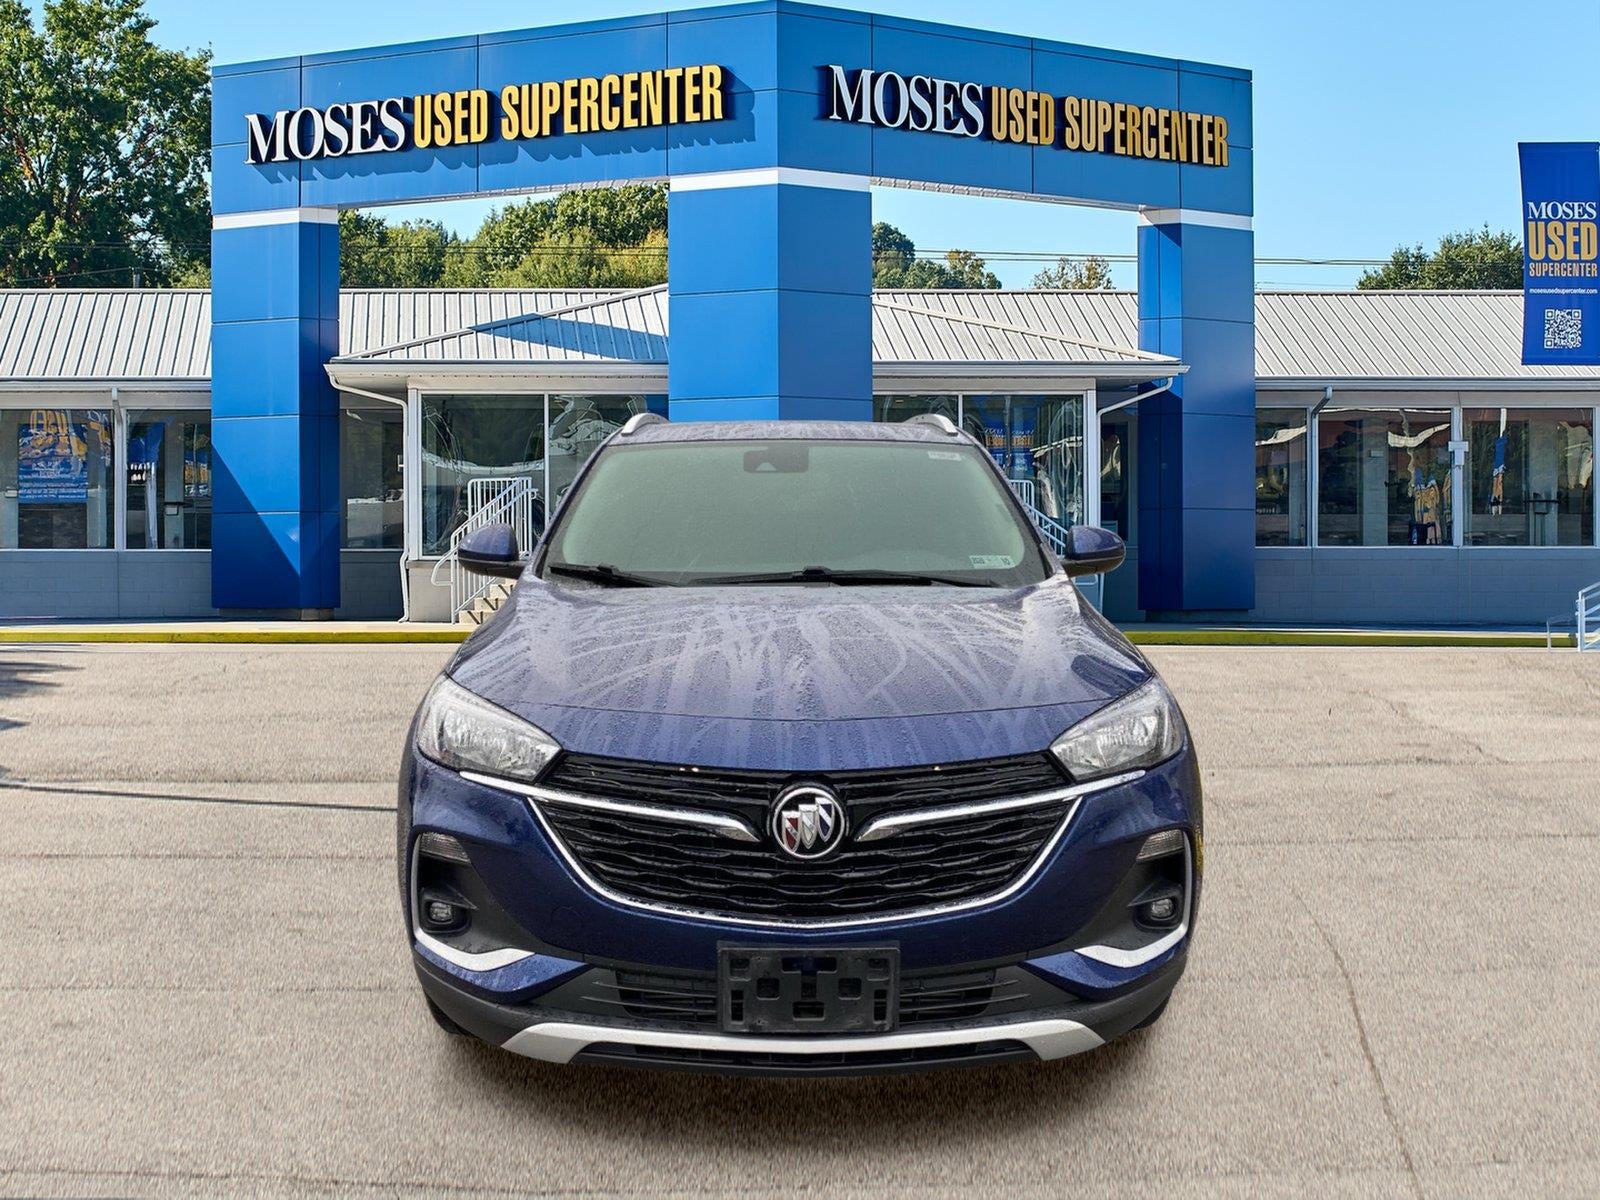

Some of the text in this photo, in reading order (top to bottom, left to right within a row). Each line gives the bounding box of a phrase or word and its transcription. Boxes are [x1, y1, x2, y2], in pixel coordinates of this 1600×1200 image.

[245, 64, 723, 165] MOSES USED SUPERCENTER
[829, 65, 1229, 167] MOSES USED SUPERCENTER
[1527, 201, 1597, 220] MOSES
[1528, 221, 1598, 261] USED
[1529, 262, 1598, 277] SUPERCENTER
